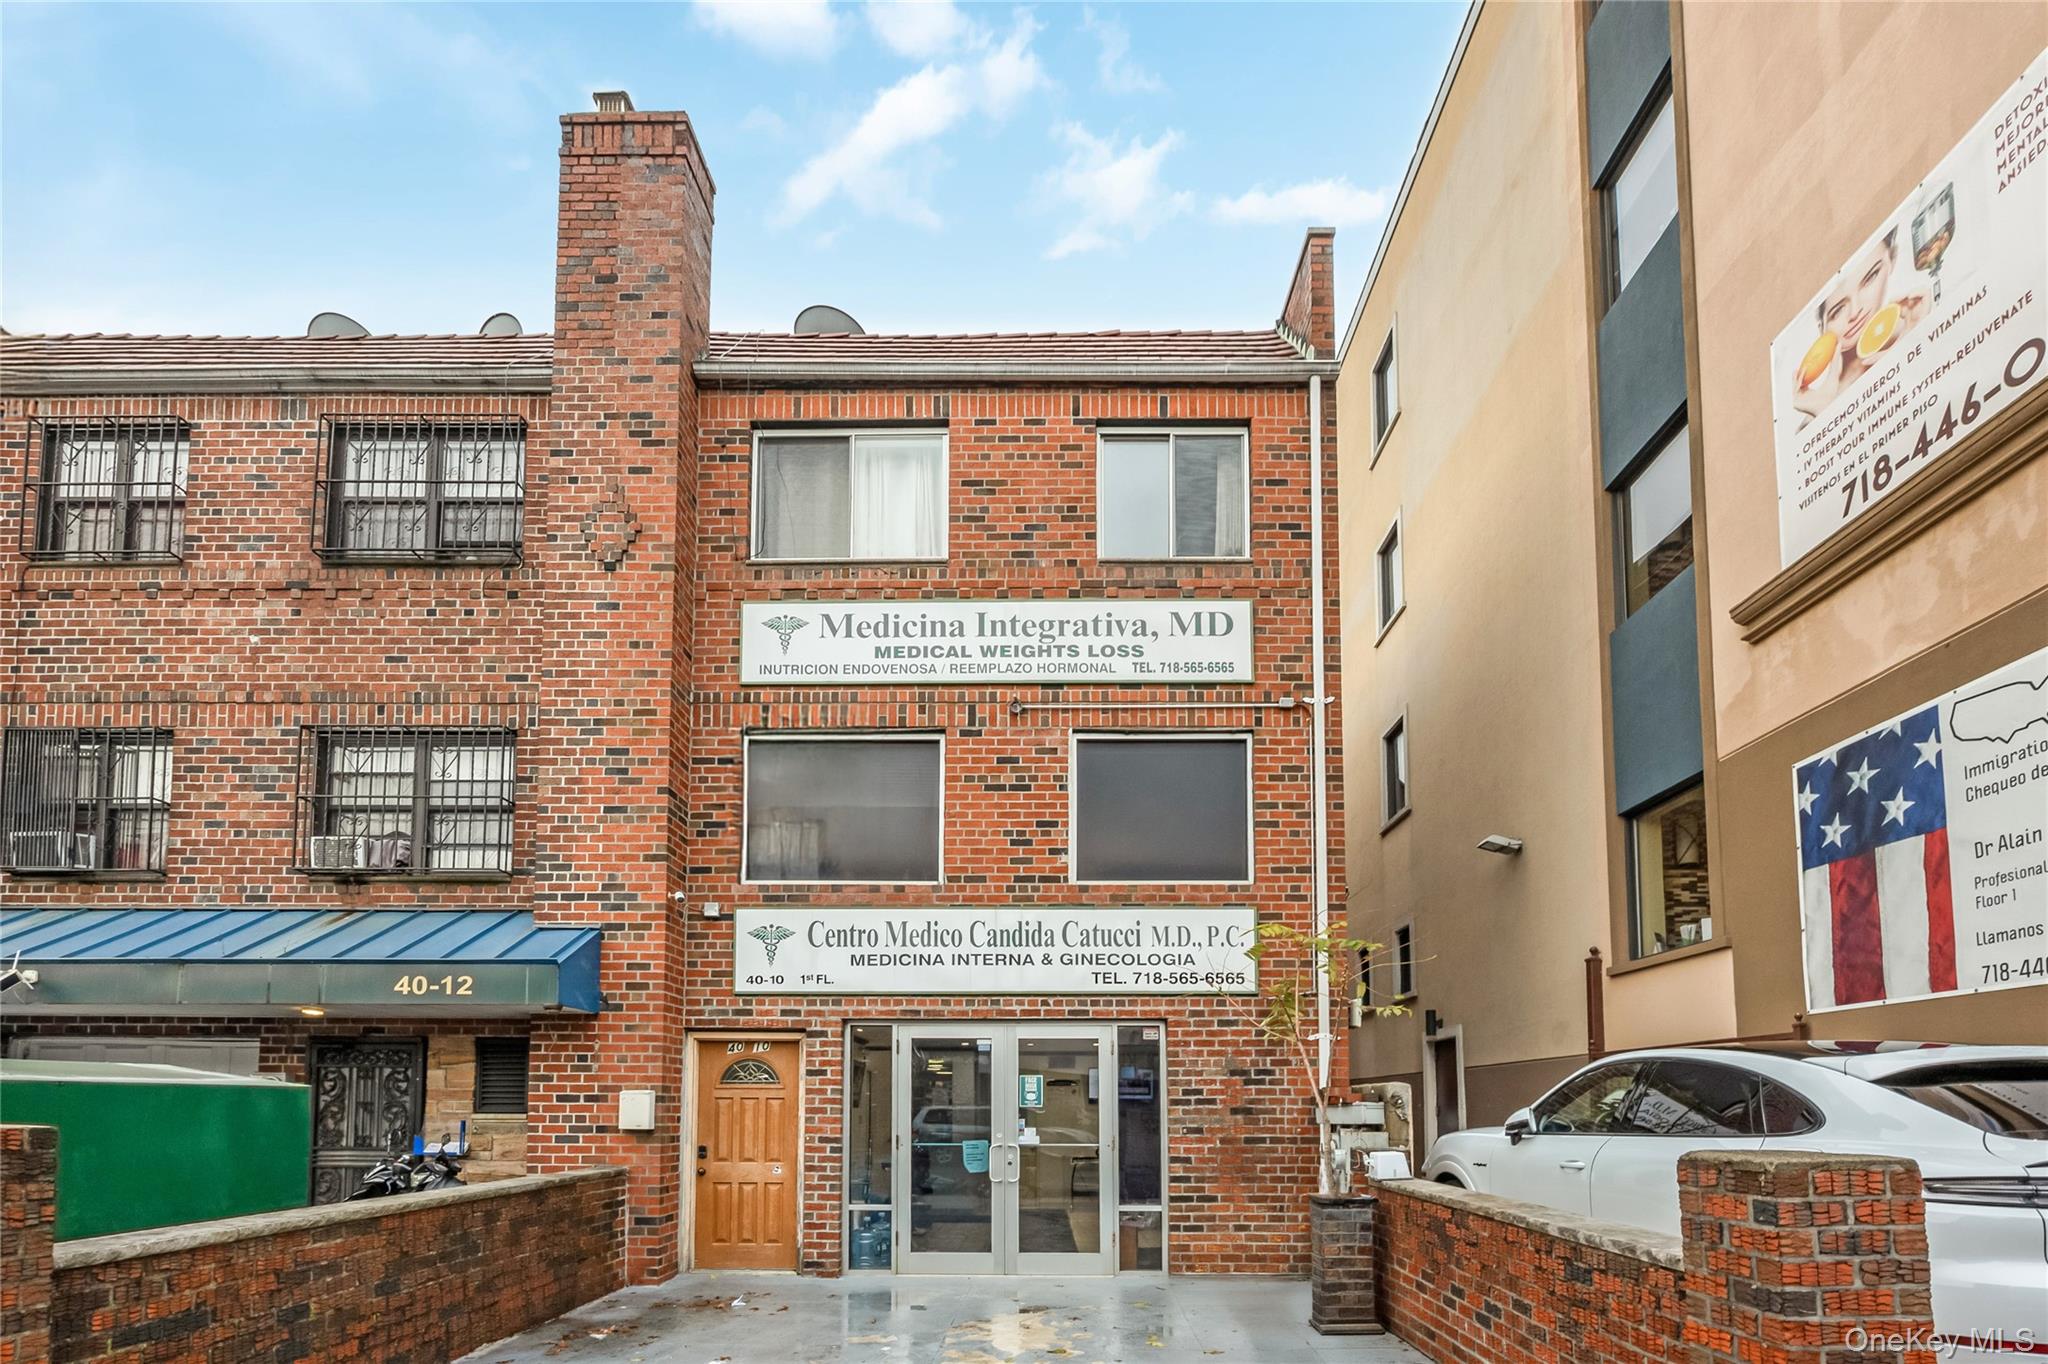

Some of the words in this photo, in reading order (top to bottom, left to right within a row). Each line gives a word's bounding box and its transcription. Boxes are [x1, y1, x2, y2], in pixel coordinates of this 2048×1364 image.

[1996, 94, 2048, 158] MEJOR
[1998, 138, 2048, 194] ANSIED
[1802, 398, 1860, 454] OFRECEMOS
[1862, 362, 1901, 404] SUEROS
[1906, 343, 1923, 364] DE
[1927, 285, 1988, 342] VITAMINAS
[1804, 456, 1834, 488] BOOST
[1836, 431, 1865, 460] YOUR
[1867, 394, 1908, 435] IMMUNE
[1911, 289, 2033, 400] SYSTEM-REJUVENATE
[1814, 420, 1855, 462] THERAPY
[1856, 381, 1902, 424] VITAMINS
[1798, 472, 1842, 511] VISITENOS
[1843, 460, 1856, 477] EN
[1858, 450, 1870, 465] EL
[1872, 417, 1910, 453] PRIMER
[1912, 393, 1939, 421] PISO
[819, 613, 966, 639] Medicina
[976, 611, 1159, 645] Integrativa,
[1169, 611, 1234, 637] MD
[874, 645, 973, 659] MEDICAL
[979, 644, 1080, 658] WEIGHTS
[1087, 644, 1145, 658] LOSS
[759, 663, 839, 676] INUTRICION
[842, 663, 938, 675] ENDOVENOSA
[949, 662, 1033, 674] REEMPLAZO
[1037, 662, 1117, 674] HORMONAL
[1131, 661, 1157, 674] TEL.
[1965, 773, 2026, 803] Chequeo
[1974, 841, 1993, 859] Dr
[1998, 828, 2042, 853] Alain
[1975, 892, 2008, 909] Floor
[807, 920, 879, 949] Centro
[884, 920, 963, 949] Medico
[969, 920, 1056, 949] Candida
[1061, 919, 1142, 948] Catucci
[1976, 923, 2044, 947] Llamanos
[850, 953, 946, 967] MEDICINA
[951, 953, 1036, 967] INTERNA
[1040, 952, 1054, 966] &
[1059, 952, 1196, 967] GINECOLOGIA
[1981, 956, 2048, 985] 718-44
[393, 975, 473, 996] 40-12
[745, 974, 785, 985] 40-10
[816, 973, 835, 985] FL.
[1090, 971, 1128, 985] TEL.
[1132, 971, 1246, 986] 718-565-6565
